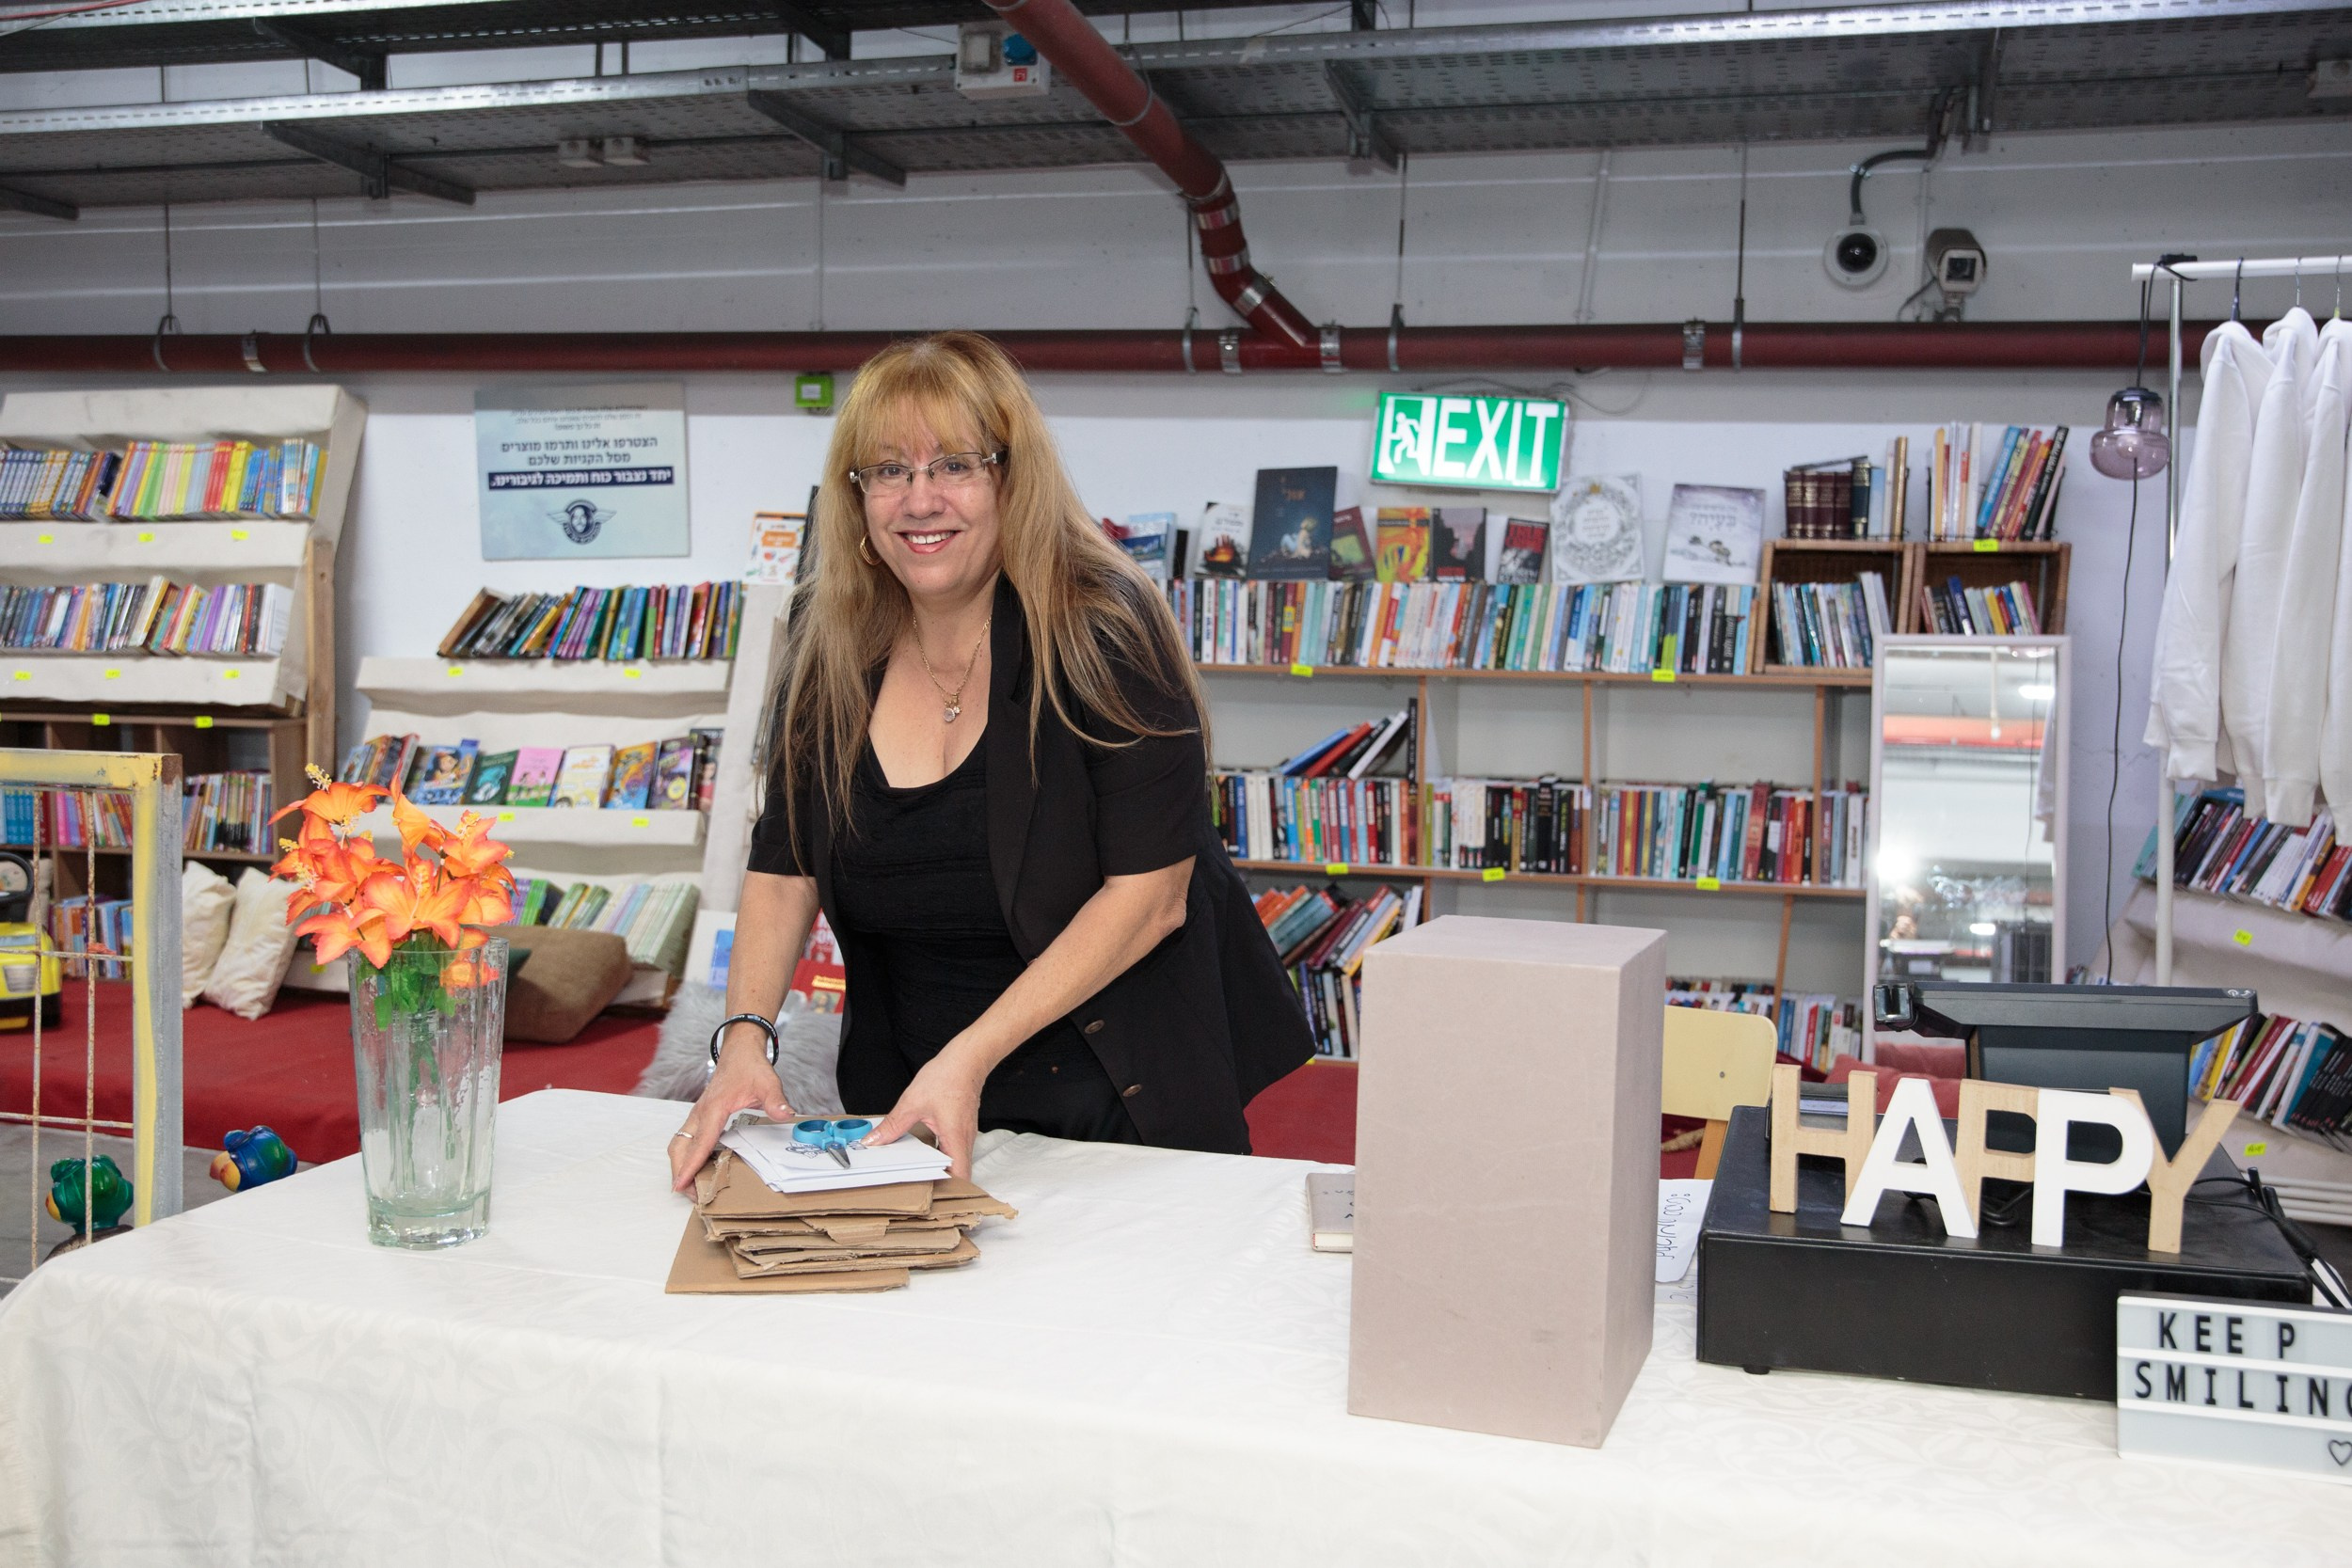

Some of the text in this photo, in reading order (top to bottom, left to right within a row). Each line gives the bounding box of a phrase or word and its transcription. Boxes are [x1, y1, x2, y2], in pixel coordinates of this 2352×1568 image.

[501, 437, 658, 452] הצטרפו אלינו ותרמו מוצרים
[1432, 397, 1560, 483] EXIT
[528, 450, 631, 467] מסל הקניות שלכם
[545, 473, 589, 485] ותמיכה
[590, 472, 612, 484] כוח
[613, 471, 647, 483] נצבור
[649, 469, 672, 482] יחד
[1770, 1064, 2241, 1254] HAPPY
[2158, 1310, 2296, 1359] KEEP
